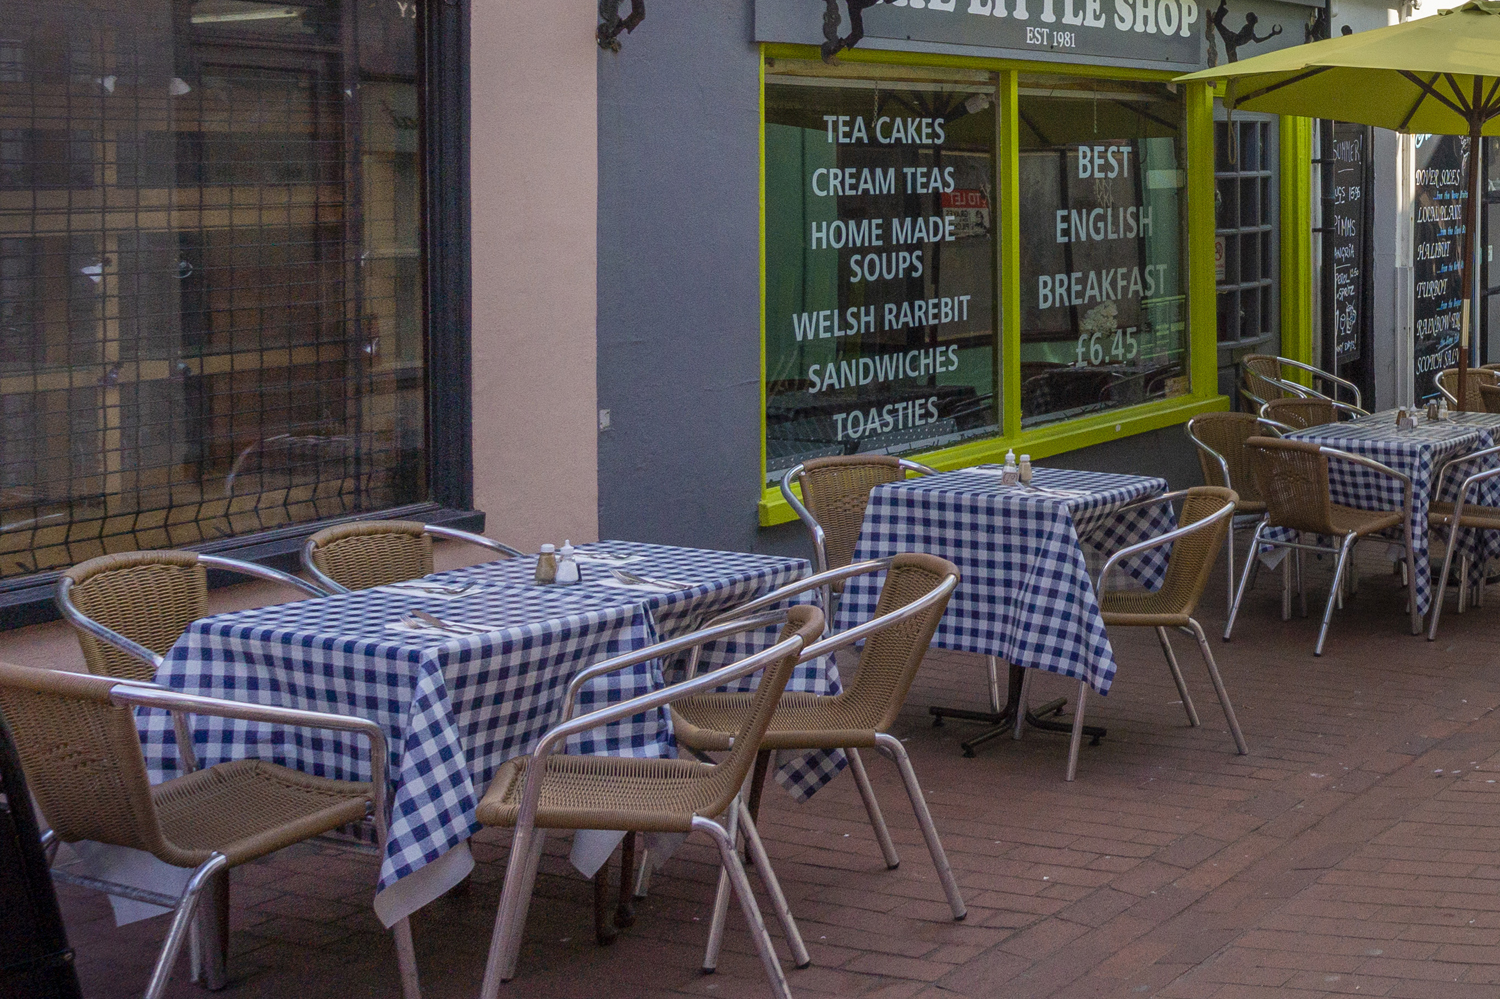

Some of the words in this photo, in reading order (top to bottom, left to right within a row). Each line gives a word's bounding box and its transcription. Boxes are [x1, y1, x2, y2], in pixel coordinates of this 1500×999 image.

[1026, 26, 1050, 46] EST
[1052, 30, 1077, 49] 1981
[823, 114, 868, 144] TEA
[875, 115, 946, 144] CAKES
[1077, 145, 1132, 179] BEST
[1416, 168, 1439, 188] DOVER
[811, 167, 895, 197] CREAM
[902, 166, 955, 194] TEAS
[811, 217, 883, 250] HOME
[892, 215, 956, 245] MADE
[1055, 206, 1153, 244] ENGLISH
[849, 250, 923, 284] SOUPS
[1417, 241, 1451, 260] HALIBUT
[1038, 263, 1167, 310] BREAKFAST
[1416, 278, 1448, 300] TURBOT
[793, 305, 876, 342] WELSH
[884, 295, 971, 332] RAREBIT
[1076, 327, 1138, 368] £6.45
[808, 344, 959, 394] SANDWICHES
[833, 396, 939, 441] TOASTIES
